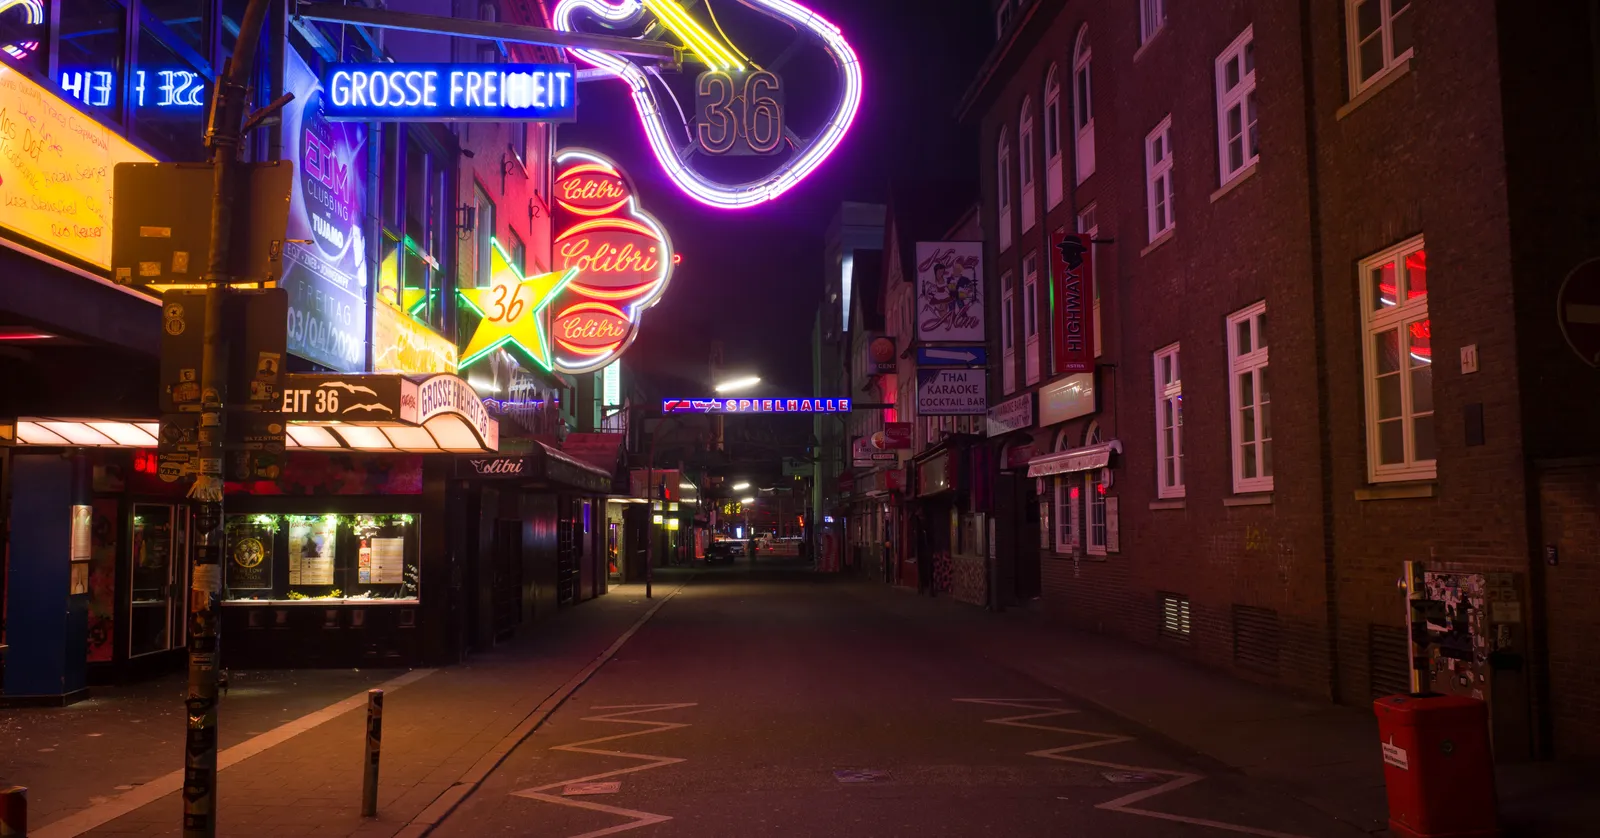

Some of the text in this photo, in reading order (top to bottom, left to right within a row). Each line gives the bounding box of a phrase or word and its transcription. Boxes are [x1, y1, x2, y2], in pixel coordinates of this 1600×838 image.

[332, 70, 571, 108] GROSSE FREIHEIT
[698, 71, 780, 152] 36
[305, 128, 349, 204] EDM
[308, 178, 348, 221] CLUBBING
[562, 178, 624, 200] Colibri
[560, 238, 659, 272] Colibri
[300, 280, 350, 326] FREITAG
[488, 283, 524, 323] 36
[1066, 270, 1082, 352] HIGHWAY
[288, 306, 360, 364] 03/04/2020
[562, 317, 624, 338] Colibri
[941, 372, 967, 382] THAI
[1463, 350, 1474, 368] 41
[282, 389, 339, 414] EIT 36
[726, 399, 848, 412] SPIELHALLE
[920, 398, 984, 406] COCKTAIL BAR
[928, 384, 978, 394] KARAOKE
[422, 379, 488, 438] GROSSE FREIHEIT 36
